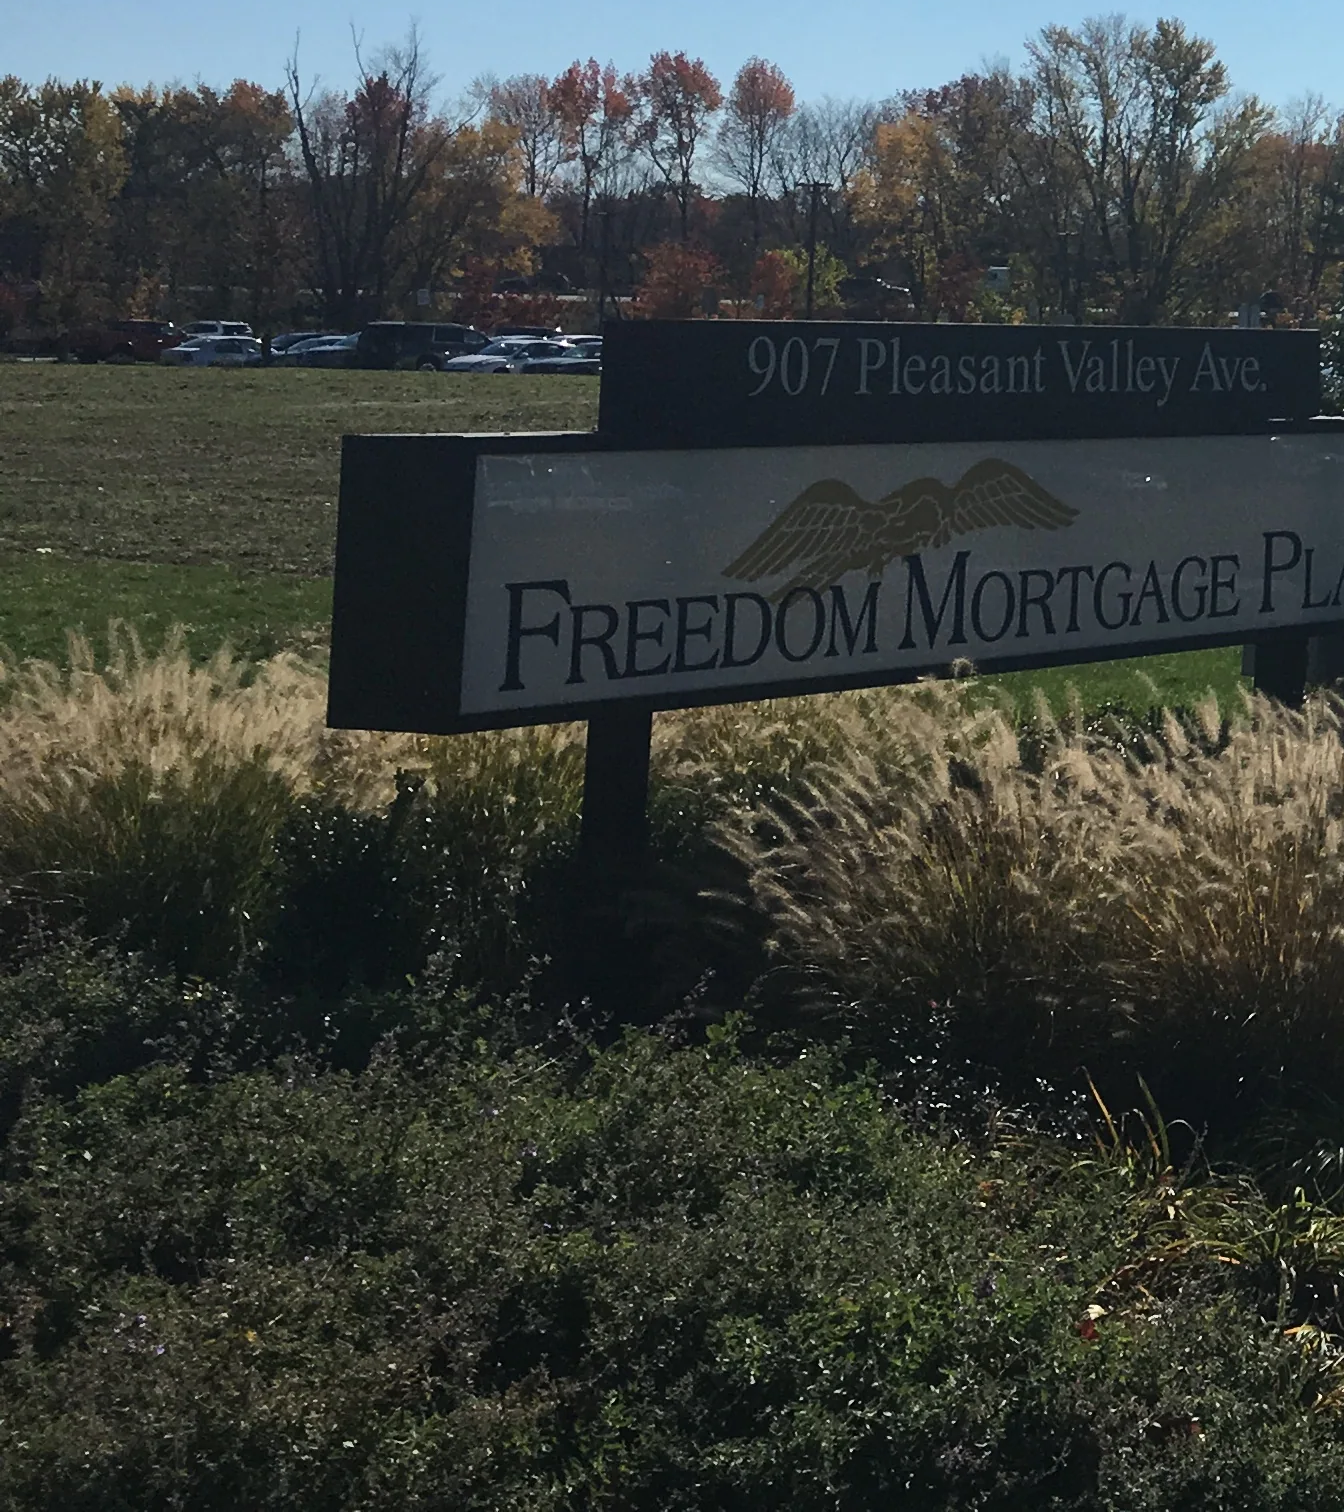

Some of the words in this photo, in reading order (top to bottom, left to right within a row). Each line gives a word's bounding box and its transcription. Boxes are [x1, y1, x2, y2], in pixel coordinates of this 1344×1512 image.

[747, 335, 840, 396] 907
[855, 335, 1047, 395] Pleasant
[1058, 339, 1180, 407] Valley
[1190, 341, 1268, 392] Ave.
[499, 579, 882, 692] FREEDOM
[898, 550, 1241, 650] MORTGAGE
